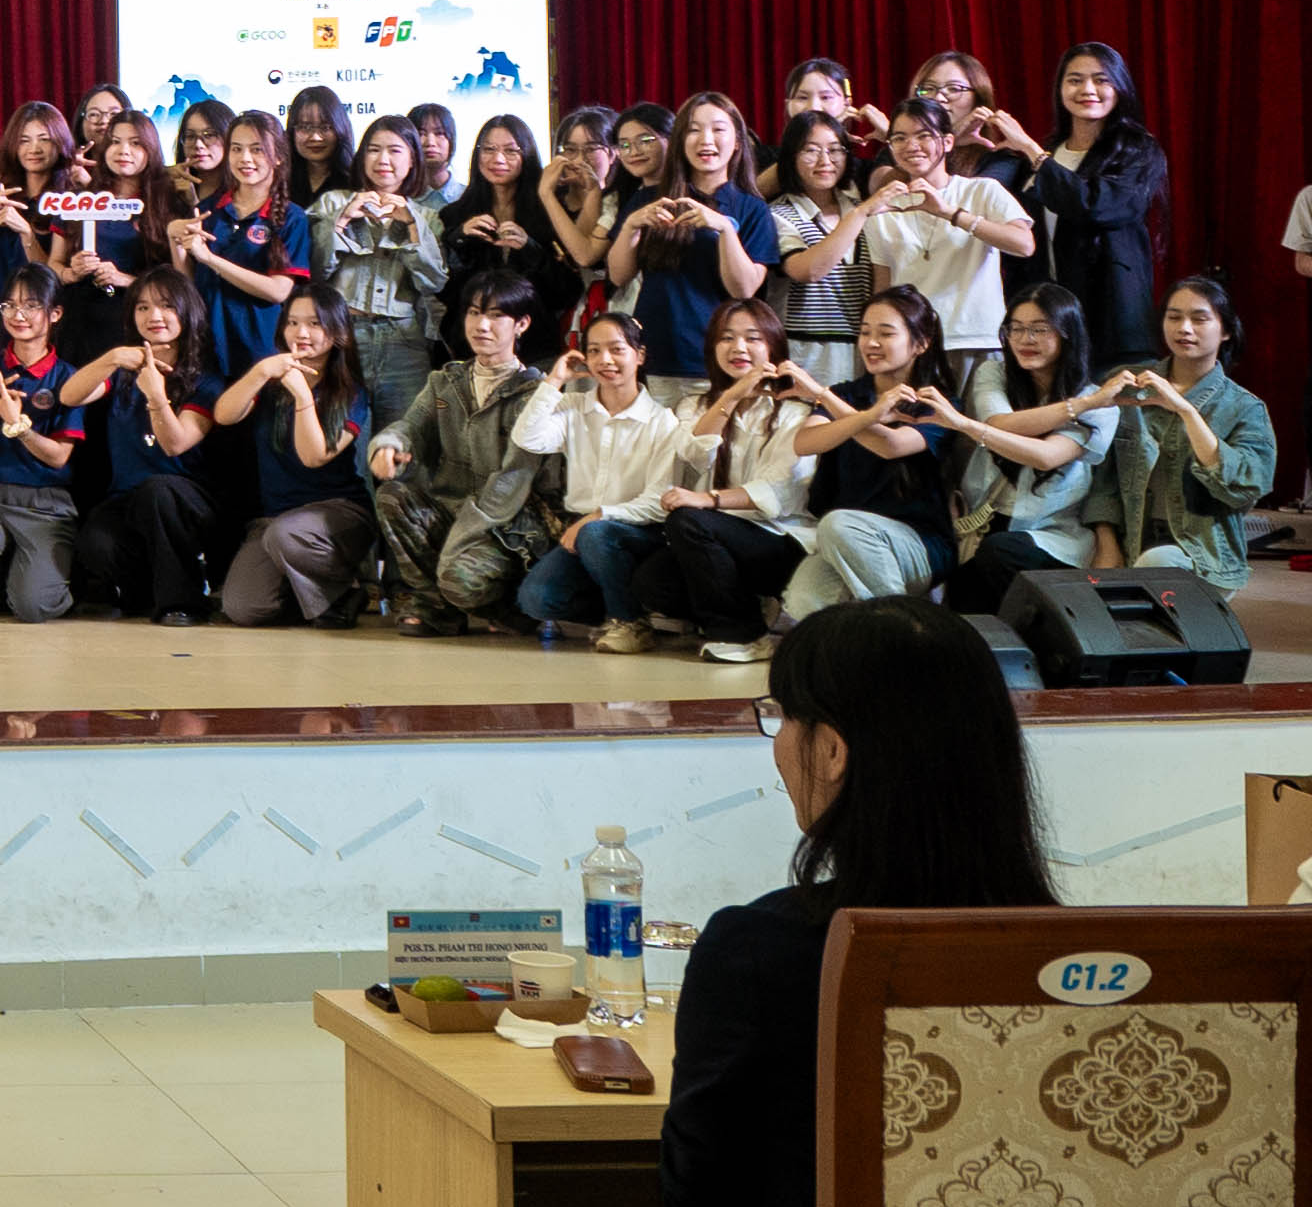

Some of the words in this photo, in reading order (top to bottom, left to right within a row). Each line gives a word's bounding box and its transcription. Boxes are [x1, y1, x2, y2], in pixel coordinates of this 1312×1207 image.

[251, 30, 287, 41] GCOO
[366, 20, 412, 43] FPT
[336, 68, 377, 82] KOICA
[357, 103, 376, 115] GIA
[1061, 962, 1129, 991] C1.2
